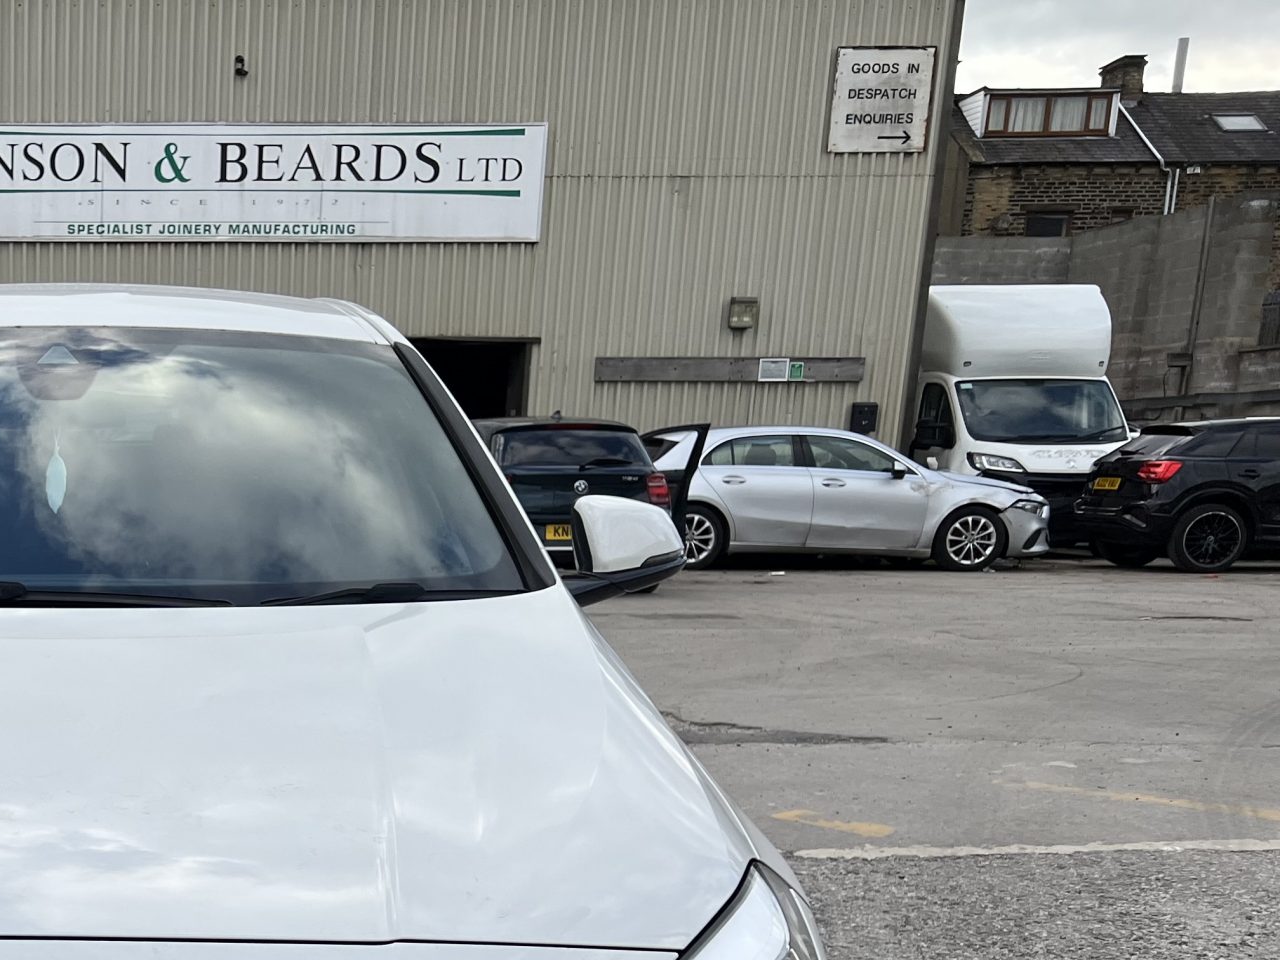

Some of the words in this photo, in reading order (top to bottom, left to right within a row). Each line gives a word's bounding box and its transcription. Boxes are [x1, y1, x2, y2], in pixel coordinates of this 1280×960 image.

[851, 63, 900, 74] GOODS
[907, 63, 920, 74] IN
[848, 88, 917, 100] DESPATCH
[845, 112, 914, 125] ENQUIRIES
[154, 142, 192, 183] &
[215, 142, 442, 183] BEARDS
[456, 157, 523, 182] LTD
[67, 224, 153, 235] SPECIALIST
[159, 224, 222, 235] JOINERY
[228, 224, 356, 235] MANUFACTURING
[553, 526, 572, 538] KN
